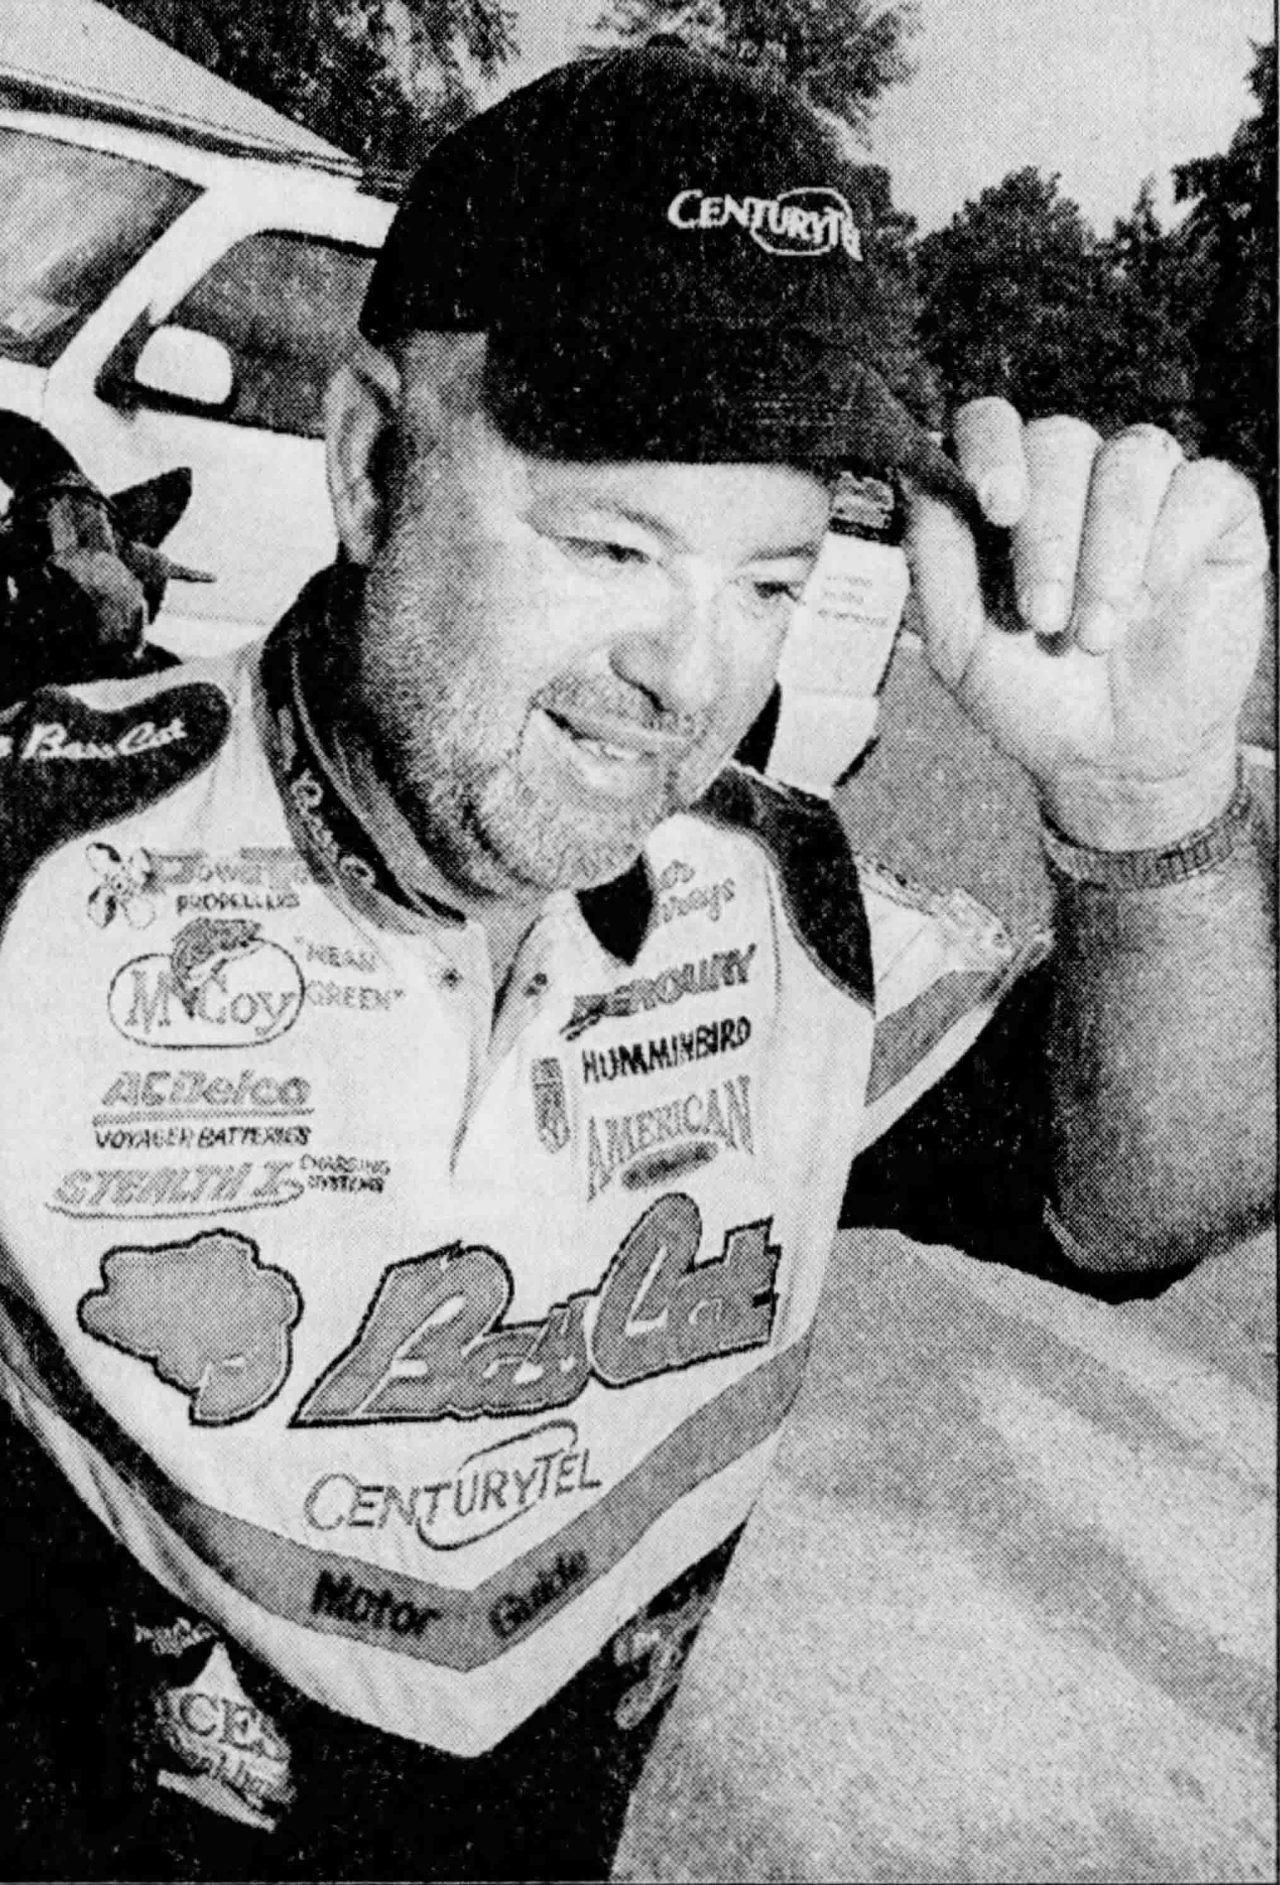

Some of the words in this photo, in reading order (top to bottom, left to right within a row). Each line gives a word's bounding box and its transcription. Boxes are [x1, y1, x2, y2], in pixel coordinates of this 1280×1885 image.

[123, 968, 300, 1037] MCoy
[581, 1016, 752, 1084] HUMMINBIRD
[92, 1129, 195, 1150] VOYAGER
[196, 1125, 312, 1148] BATTERIES
[586, 1075, 756, 1203] AMERICAN
[53, 1161, 254, 1206] STEALTH
[309, 1569, 443, 1639] Motor
